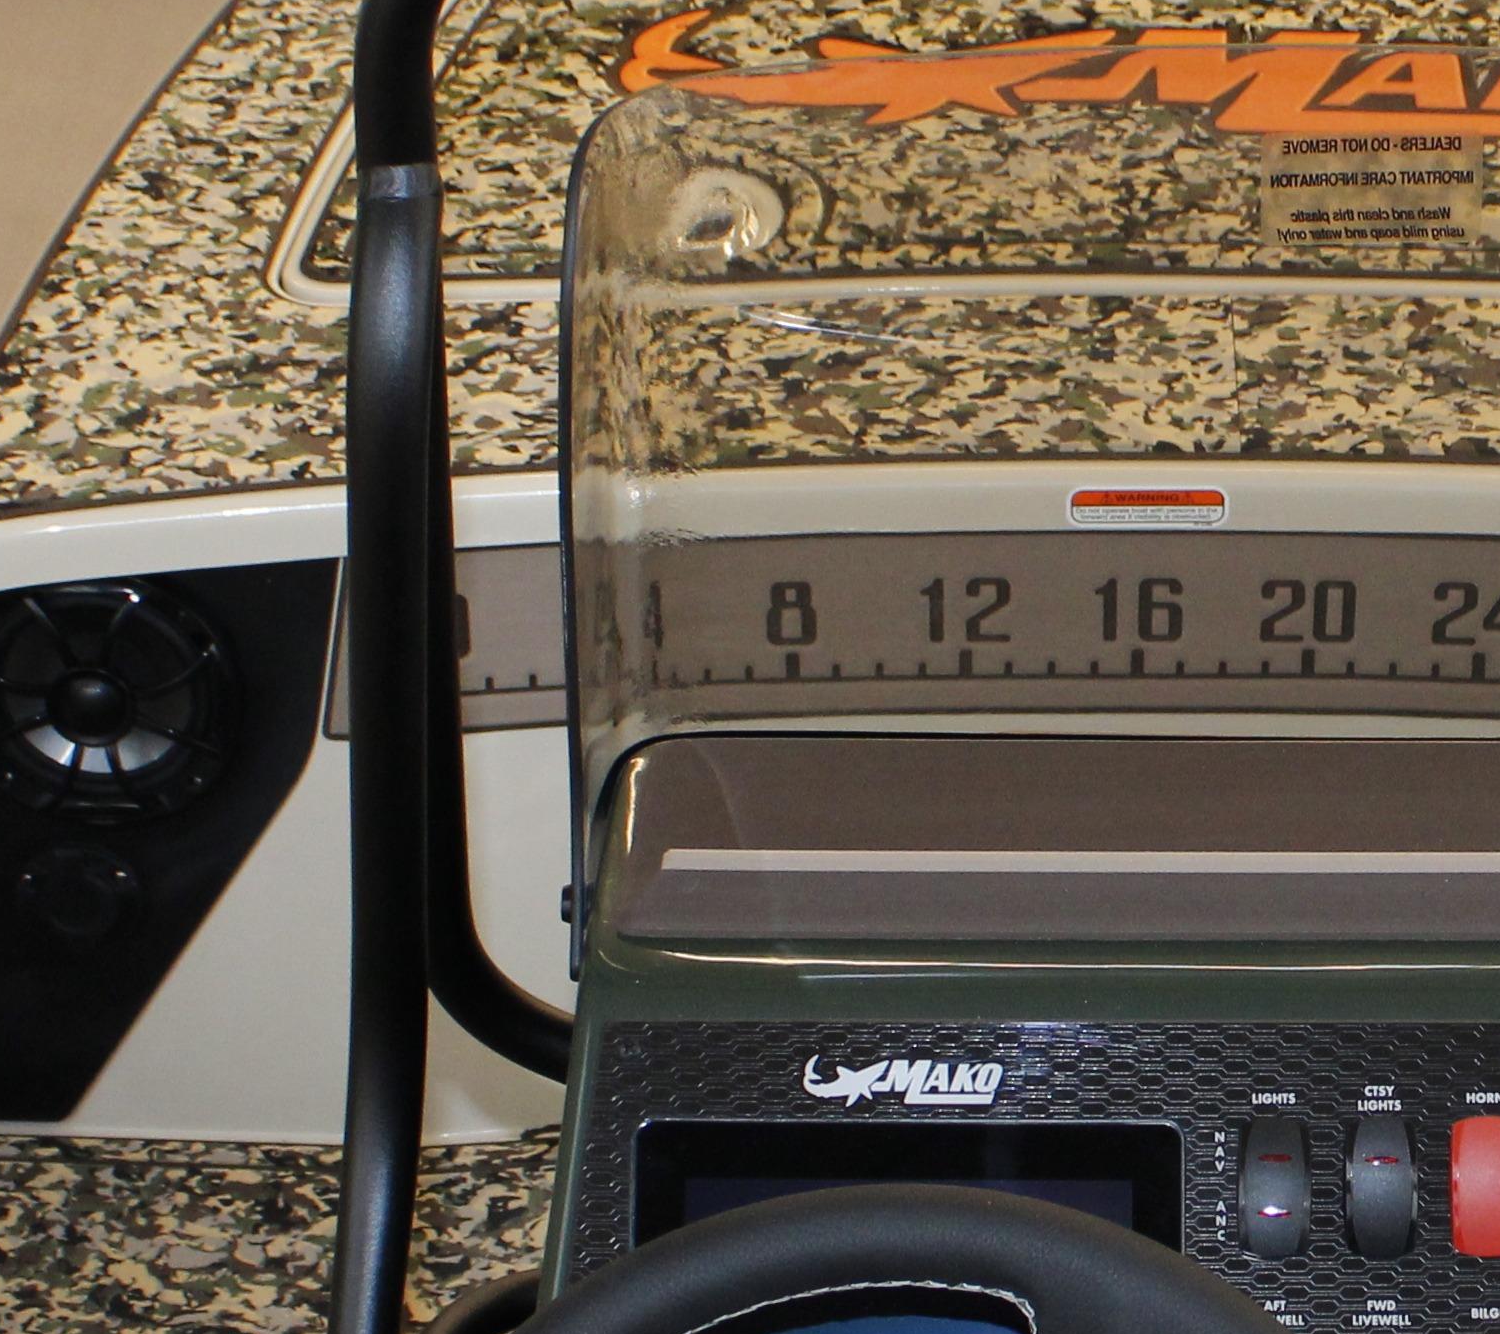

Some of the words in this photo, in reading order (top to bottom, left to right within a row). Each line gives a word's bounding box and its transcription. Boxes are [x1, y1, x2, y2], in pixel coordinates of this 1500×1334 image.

[1115, 493, 1180, 501] WARNING
[766, 581, 818, 646] 8
[919, 578, 1011, 643] 12
[1094, 578, 1184, 643] 16
[1259, 579, 1357, 644] 20
[871, 1059, 1003, 1105] MAKO
[1364, 1085, 1395, 1097] CTSY
[1252, 1092, 1296, 1105] LIGHTS
[1357, 1099, 1401, 1112] LIGHTS
[1264, 1300, 1287, 1312] AFT
[1366, 1299, 1396, 1311] FWD
[1275, 1314, 1305, 1326] WELL
[1352, 1313, 1411, 1327] LIVEWELL
